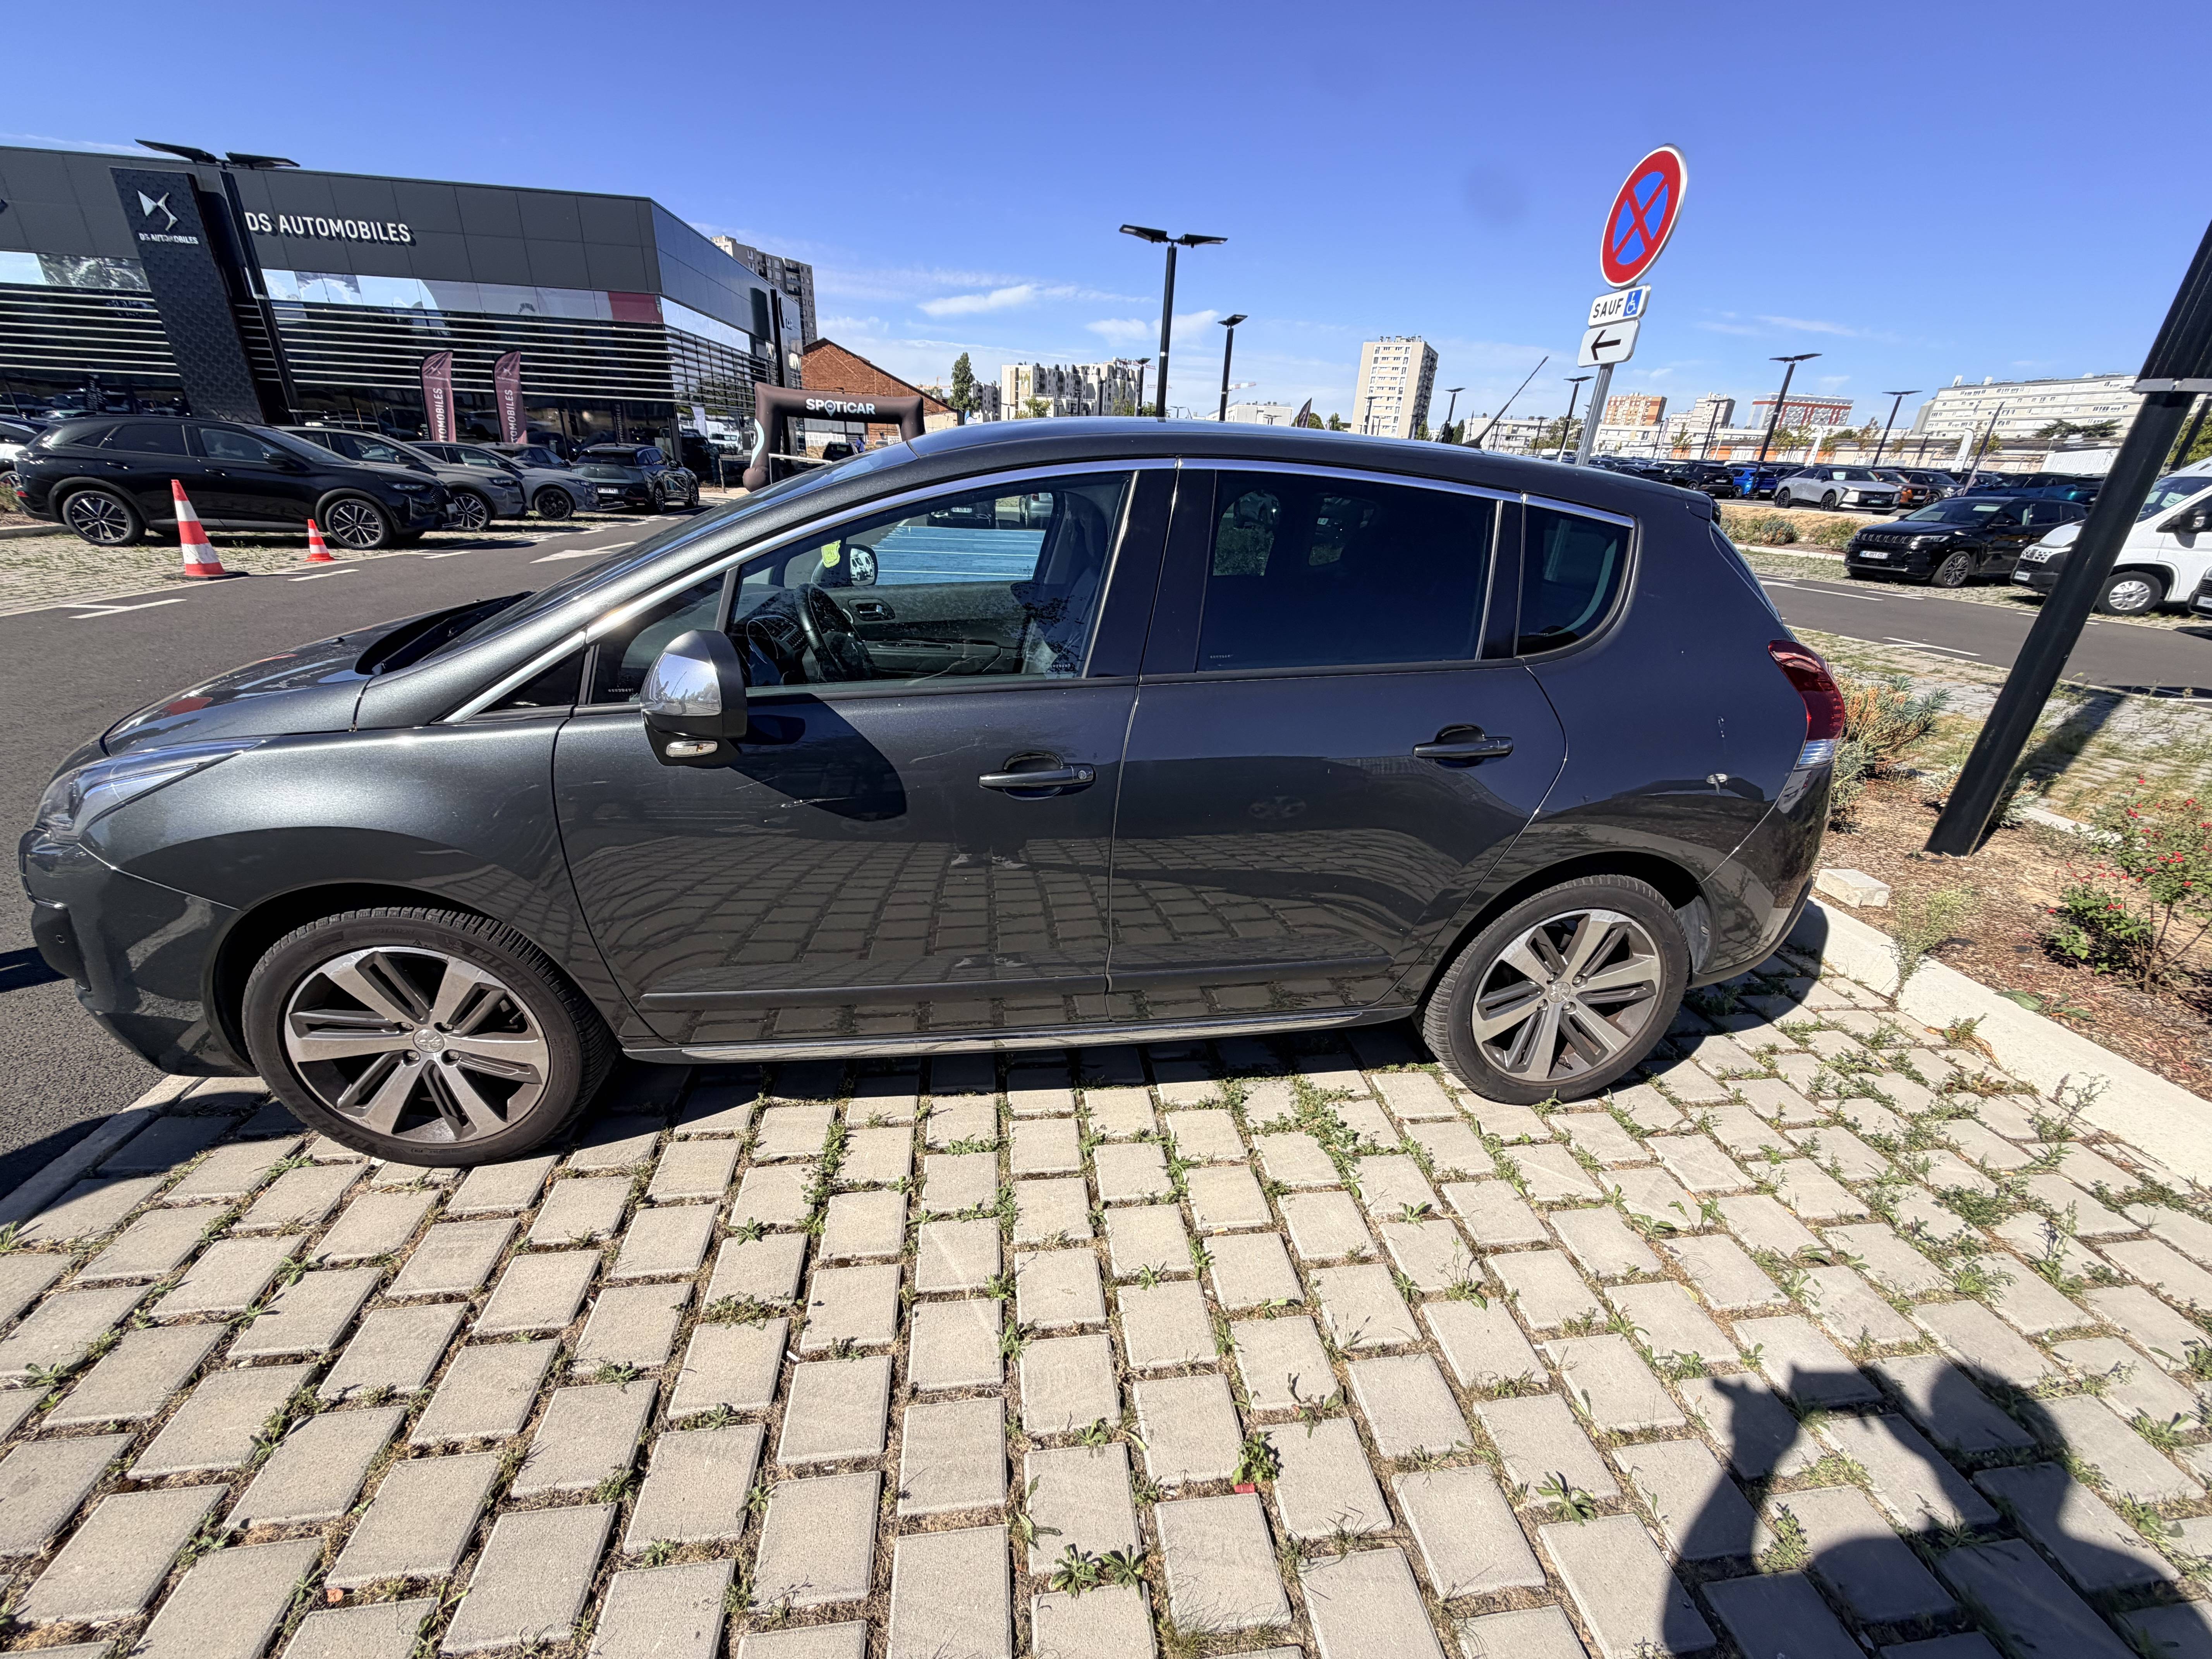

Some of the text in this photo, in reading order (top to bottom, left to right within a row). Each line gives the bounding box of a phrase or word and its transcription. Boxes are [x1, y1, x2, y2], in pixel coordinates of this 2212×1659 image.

[138, 233, 151, 241] DS
[244, 212, 411, 242] DS AUTOMOBILES
[1593, 297, 1624, 318] SAUF
